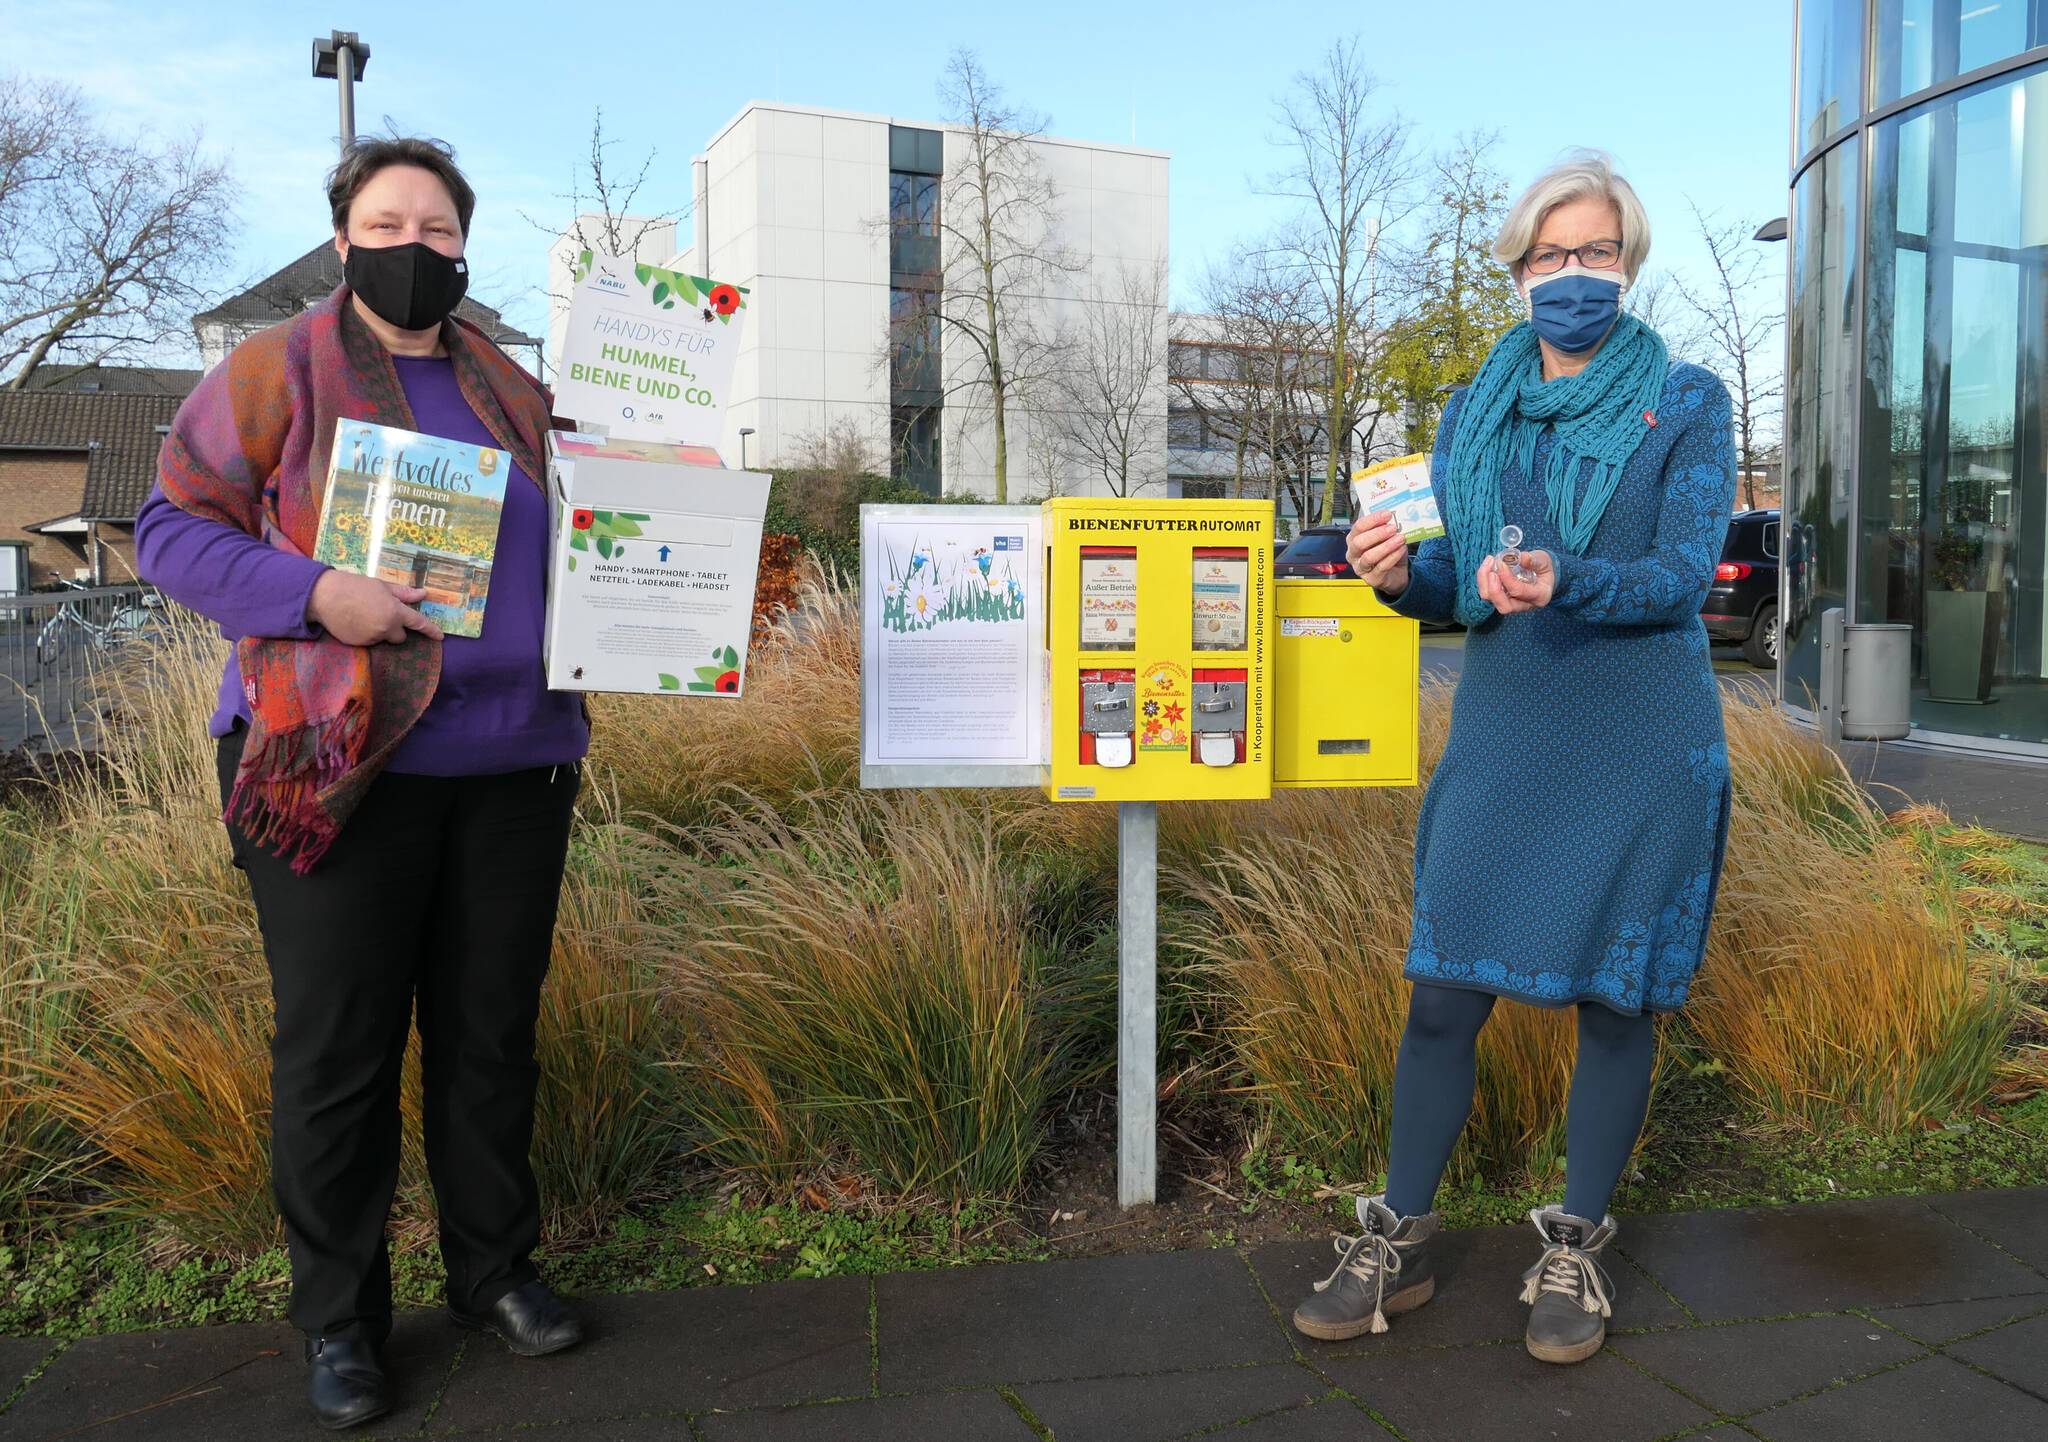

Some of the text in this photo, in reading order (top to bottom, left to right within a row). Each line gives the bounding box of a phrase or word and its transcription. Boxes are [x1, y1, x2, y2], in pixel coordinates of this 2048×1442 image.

[599, 278, 626, 290] NABU
[593, 315, 716, 356] HANDYS FÜR
[600, 343, 697, 382] HUMMEL,
[570, 363, 717, 409] BIENE UND CO.
[353, 440, 474, 493] Wetvolles
[413, 487, 451, 503] unseren
[589, 574, 731, 592] NETZTEIL LADEKABEL HEADSET
[594, 564, 728, 581] HANDY SMARTPHONE TABLET
[1085, 583, 1108, 591] Außer
[1256, 547, 1264, 664] www.bienenretter.com
[1254, 686, 1263, 750] Kooperation
[1253, 752, 1262, 762] In
